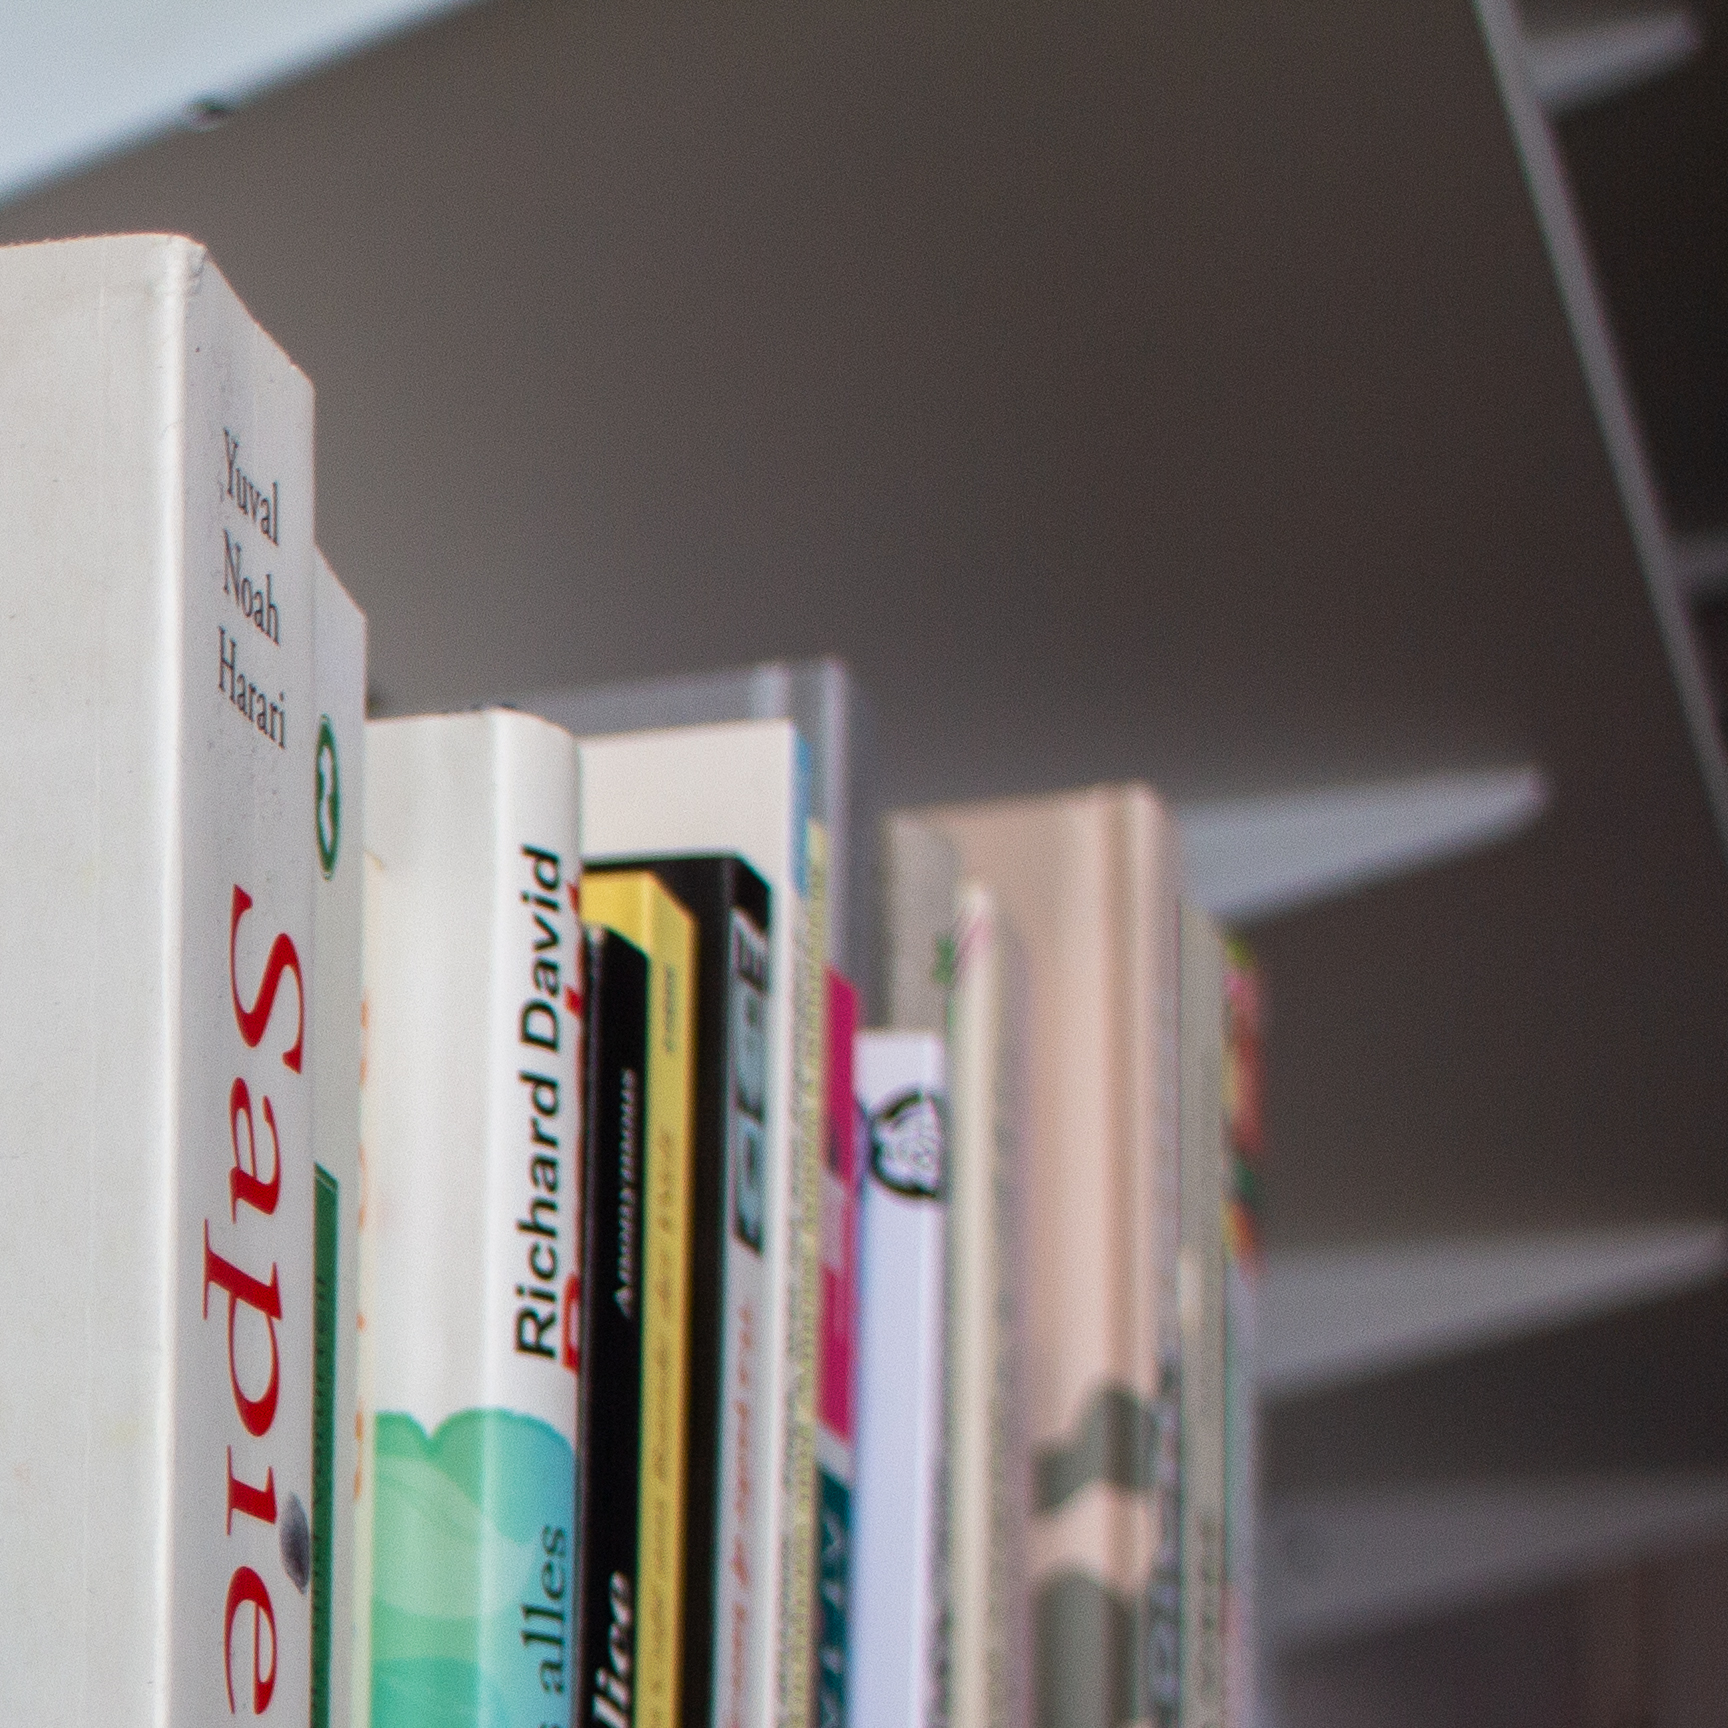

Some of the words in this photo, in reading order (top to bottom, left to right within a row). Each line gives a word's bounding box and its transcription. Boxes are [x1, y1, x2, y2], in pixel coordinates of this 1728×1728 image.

[217, 427, 279, 547] Yuval
[222, 528, 280, 646] Noah
[217, 625, 286, 750] Harari
[519, 845, 560, 1053] David
[514, 1071, 559, 1360] Richard
[519, 1525, 566, 1695] alles
